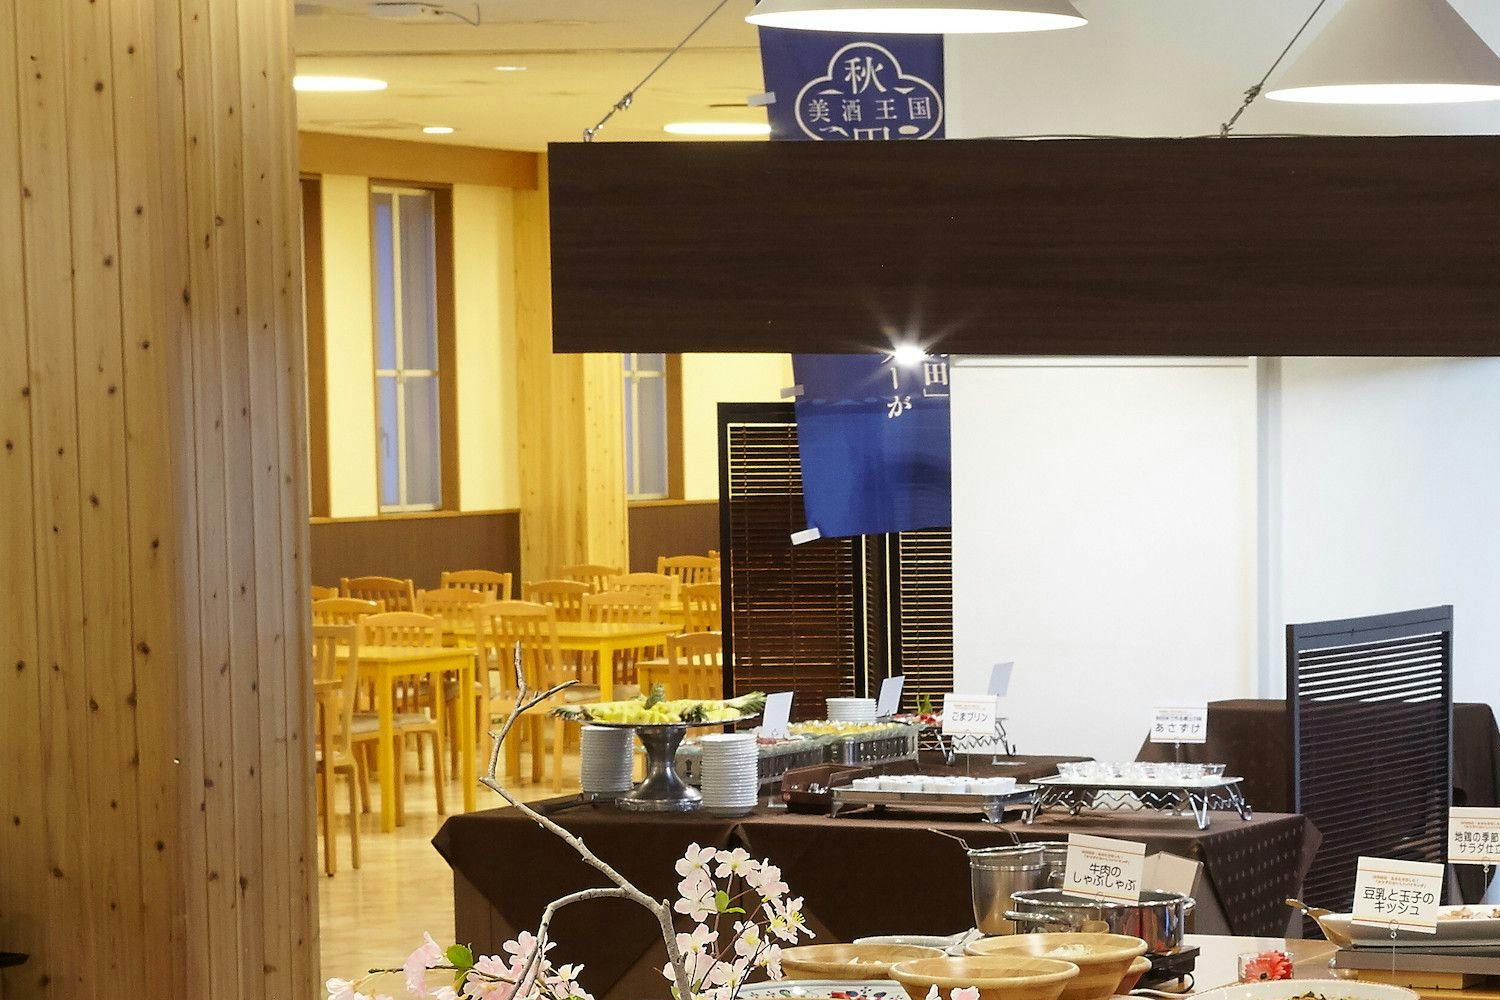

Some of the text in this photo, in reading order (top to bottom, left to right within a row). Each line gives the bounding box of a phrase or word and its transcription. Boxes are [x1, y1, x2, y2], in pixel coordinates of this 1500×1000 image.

[808, 96, 932, 123] 美酒王国
[1089, 862, 1122, 878] 牛肉の
[1073, 871, 1137, 891] しゃぶしゃぶ
[1363, 886, 1435, 905] 豆乳と玉子の
[1374, 901, 1420, 916] キッシュ
